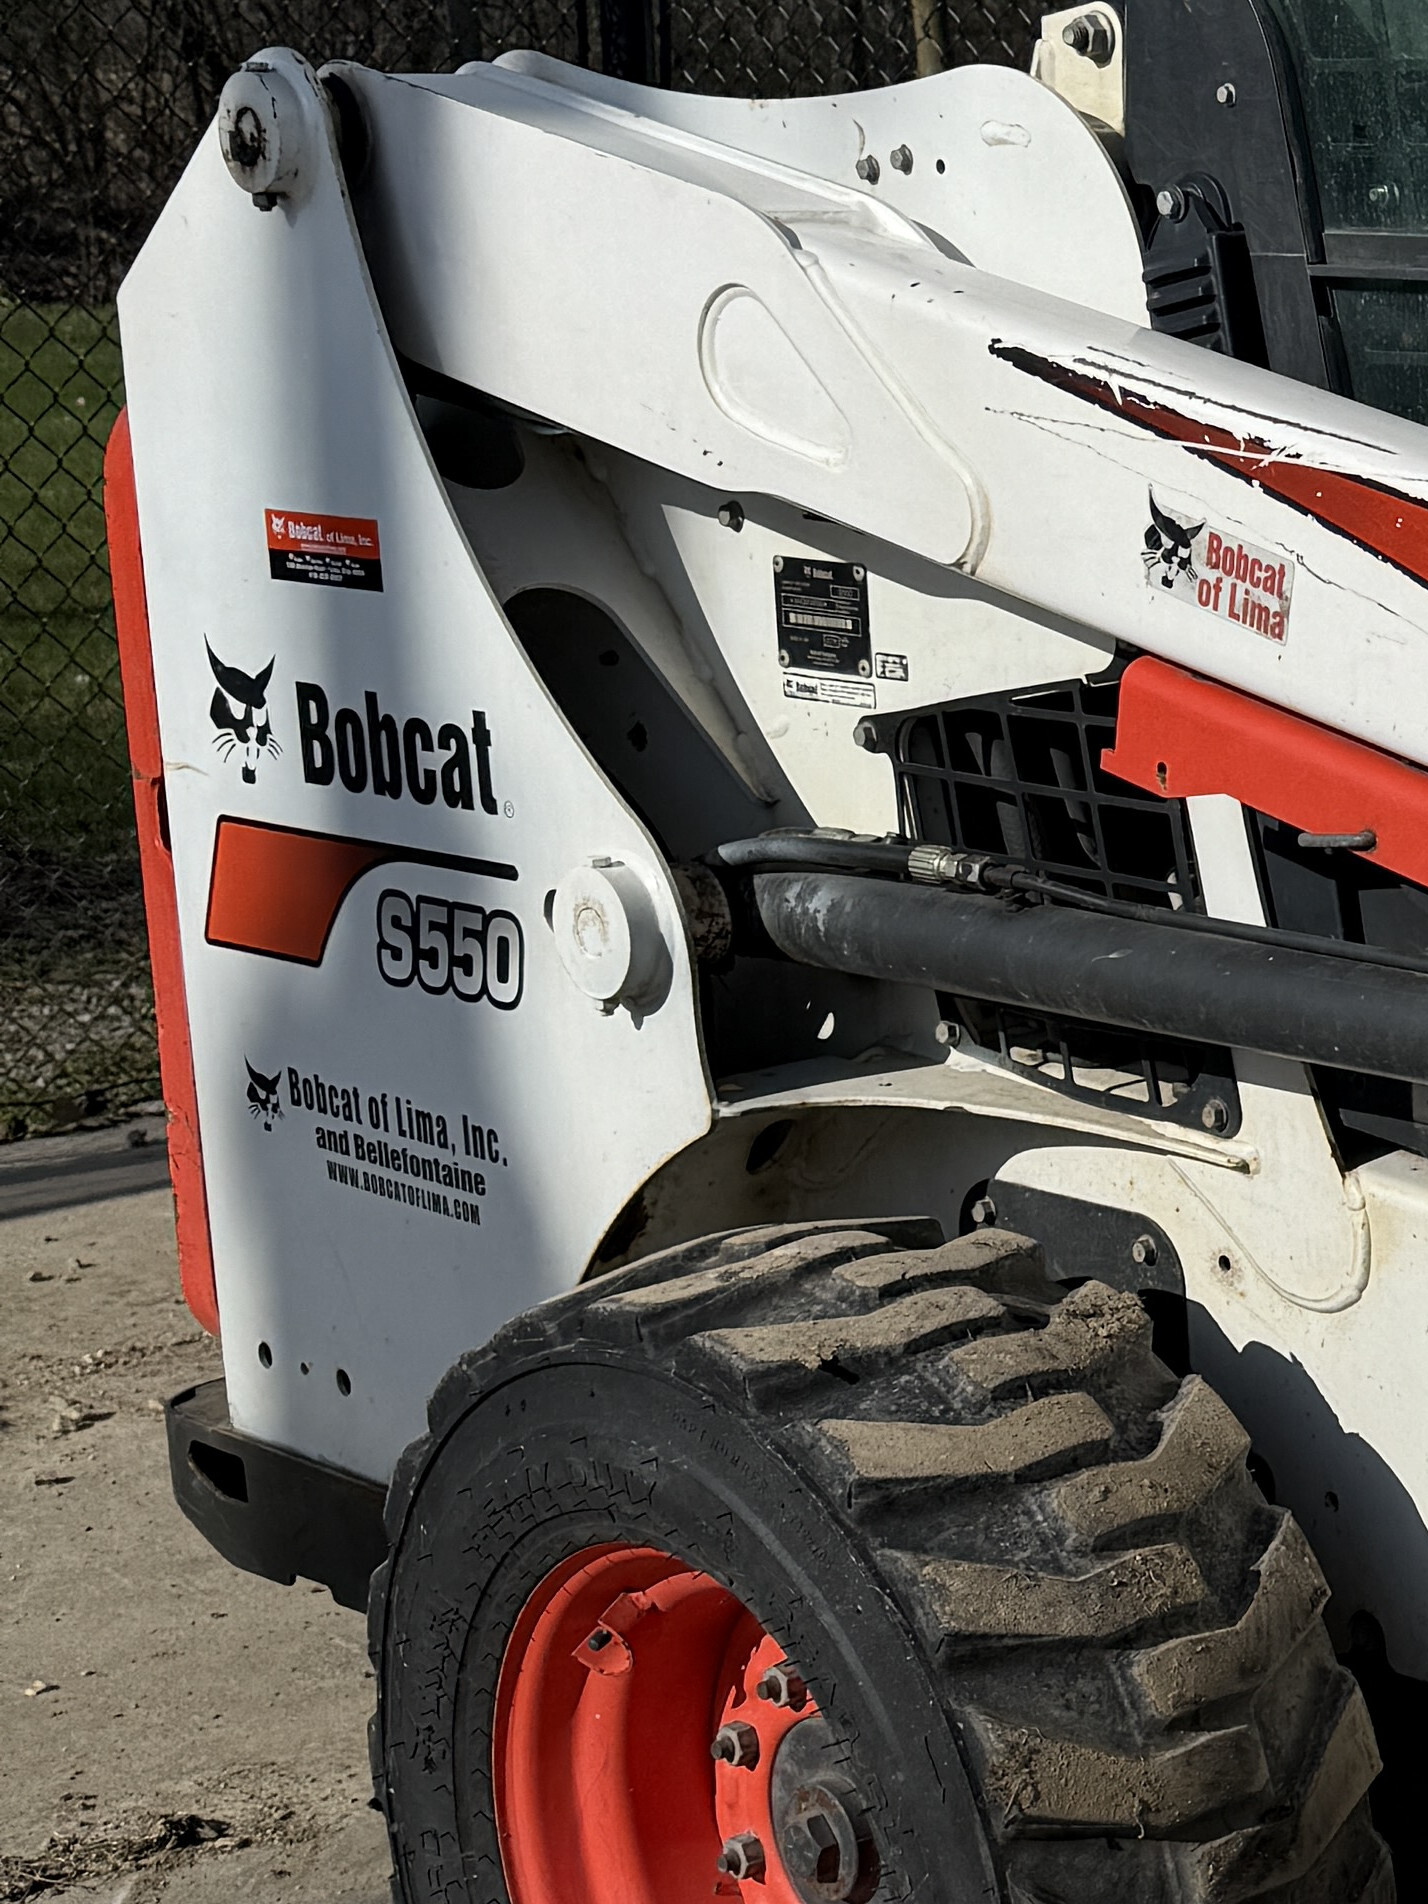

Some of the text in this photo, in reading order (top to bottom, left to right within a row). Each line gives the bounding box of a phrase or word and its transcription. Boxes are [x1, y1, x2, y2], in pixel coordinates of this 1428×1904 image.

[288, 521, 324, 542] Bobcat
[1206, 531, 1286, 600] Bobcat
[1198, 577, 1285, 641] of Lima
[295, 681, 498, 815] Bobcat
[377, 889, 524, 1010] S550
[288, 1066, 508, 1167] Bobcat of Lima, Inc.
[315, 1126, 486, 1196] and Bellefontaine
[327, 1160, 480, 1225] WWW.BOBCATOFLIMA.COM
